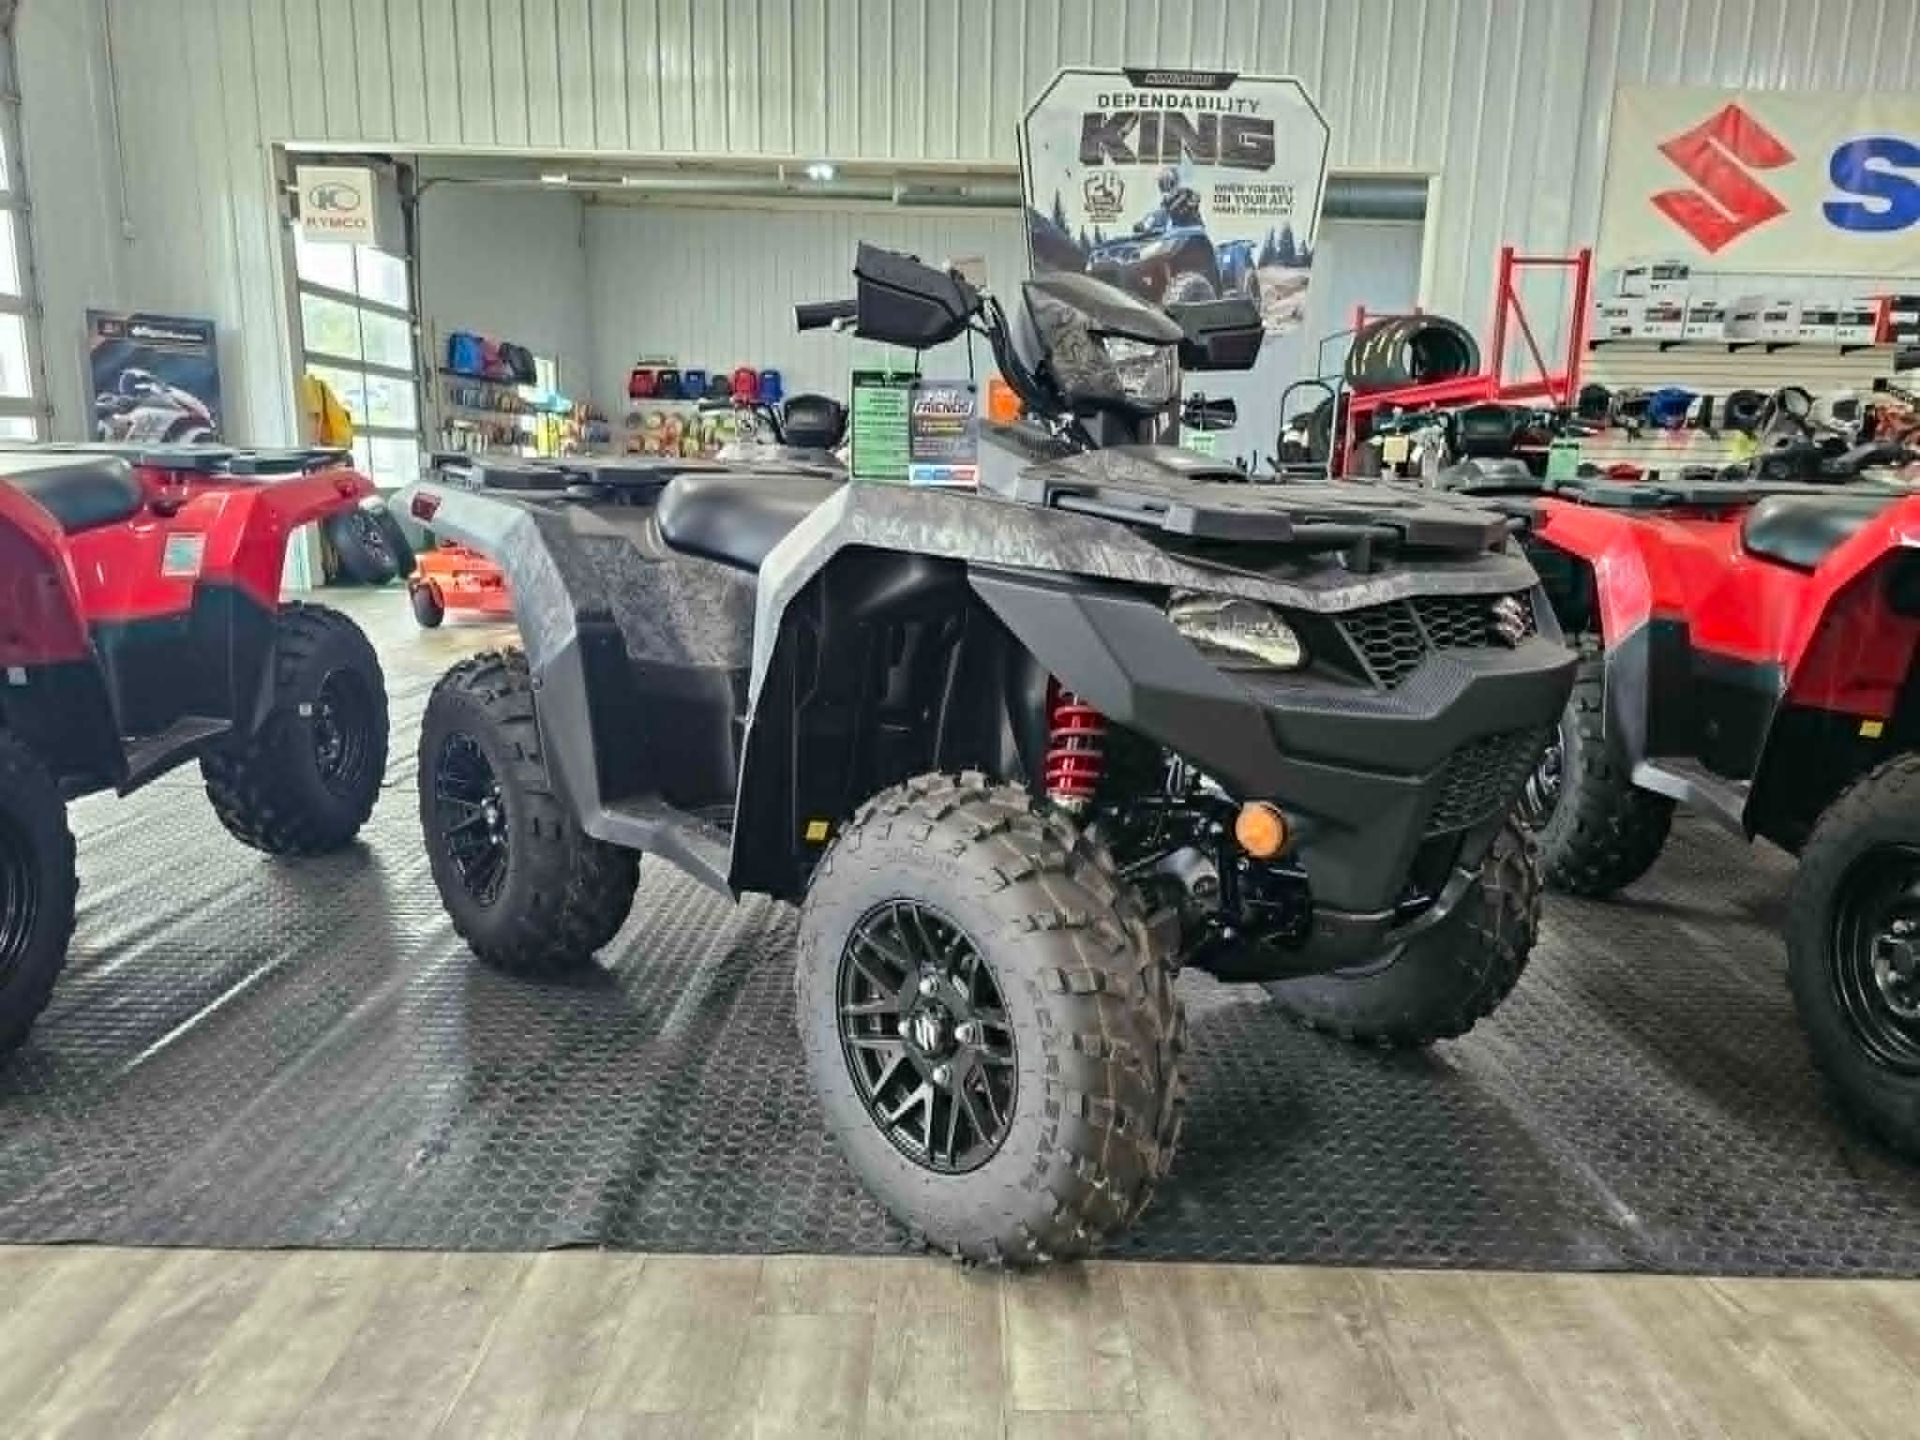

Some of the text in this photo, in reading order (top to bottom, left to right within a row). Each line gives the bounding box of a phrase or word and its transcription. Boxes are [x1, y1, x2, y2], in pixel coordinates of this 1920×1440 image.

[1098, 92, 1260, 112] DEPENDABILITY
[1080, 111, 1276, 172] KING
[1234, 194, 1267, 205] YOUR
